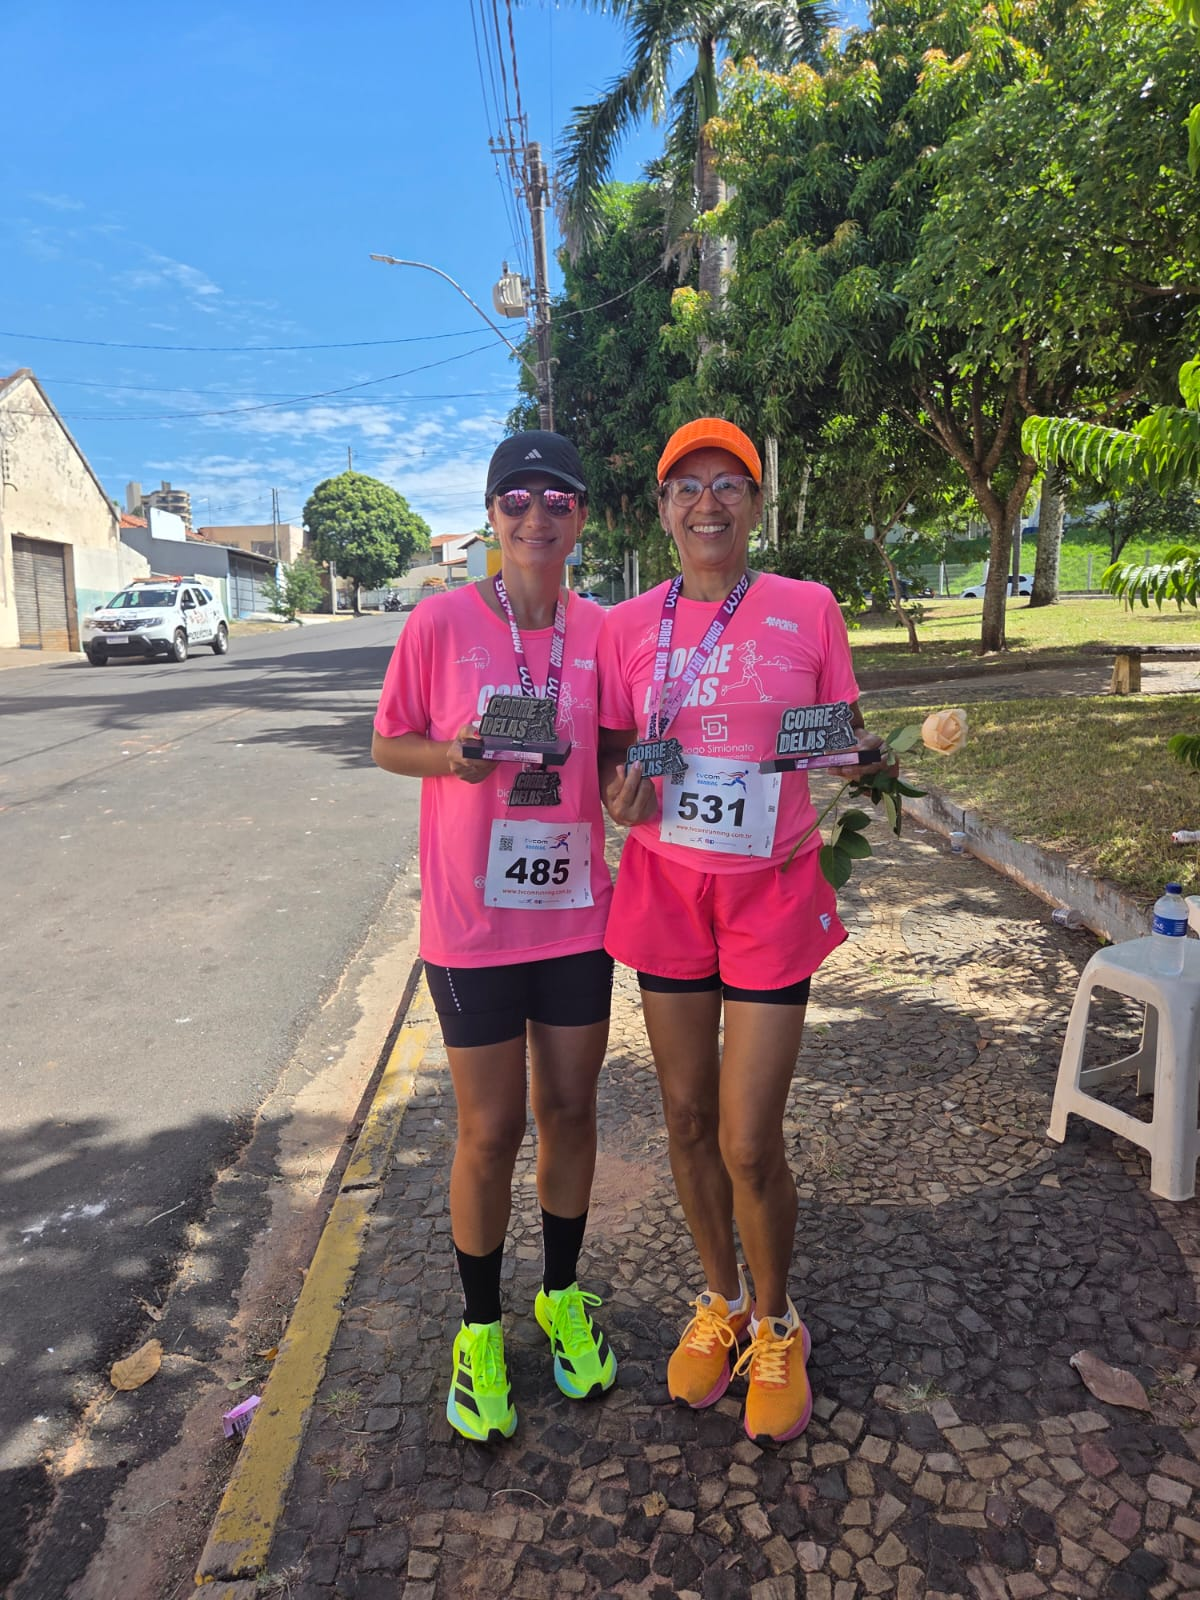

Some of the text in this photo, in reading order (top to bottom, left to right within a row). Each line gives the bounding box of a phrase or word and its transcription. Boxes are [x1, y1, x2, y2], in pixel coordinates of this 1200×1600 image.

[658, 618, 674, 648] CORRE
[700, 620, 725, 654] CORRE
[550, 632, 564, 668] CORRE
[653, 652, 669, 681] DELAS
[682, 652, 706, 685] DELAS
[489, 697, 540, 719] CORRE
[783, 707, 834, 731] CORRE
[480, 716, 529, 739] DELAS
[778, 729, 827, 753] DELAS
[629, 742, 667, 762] CORRE
[678, 791, 745, 828] 531
[505, 857, 570, 886] 485
